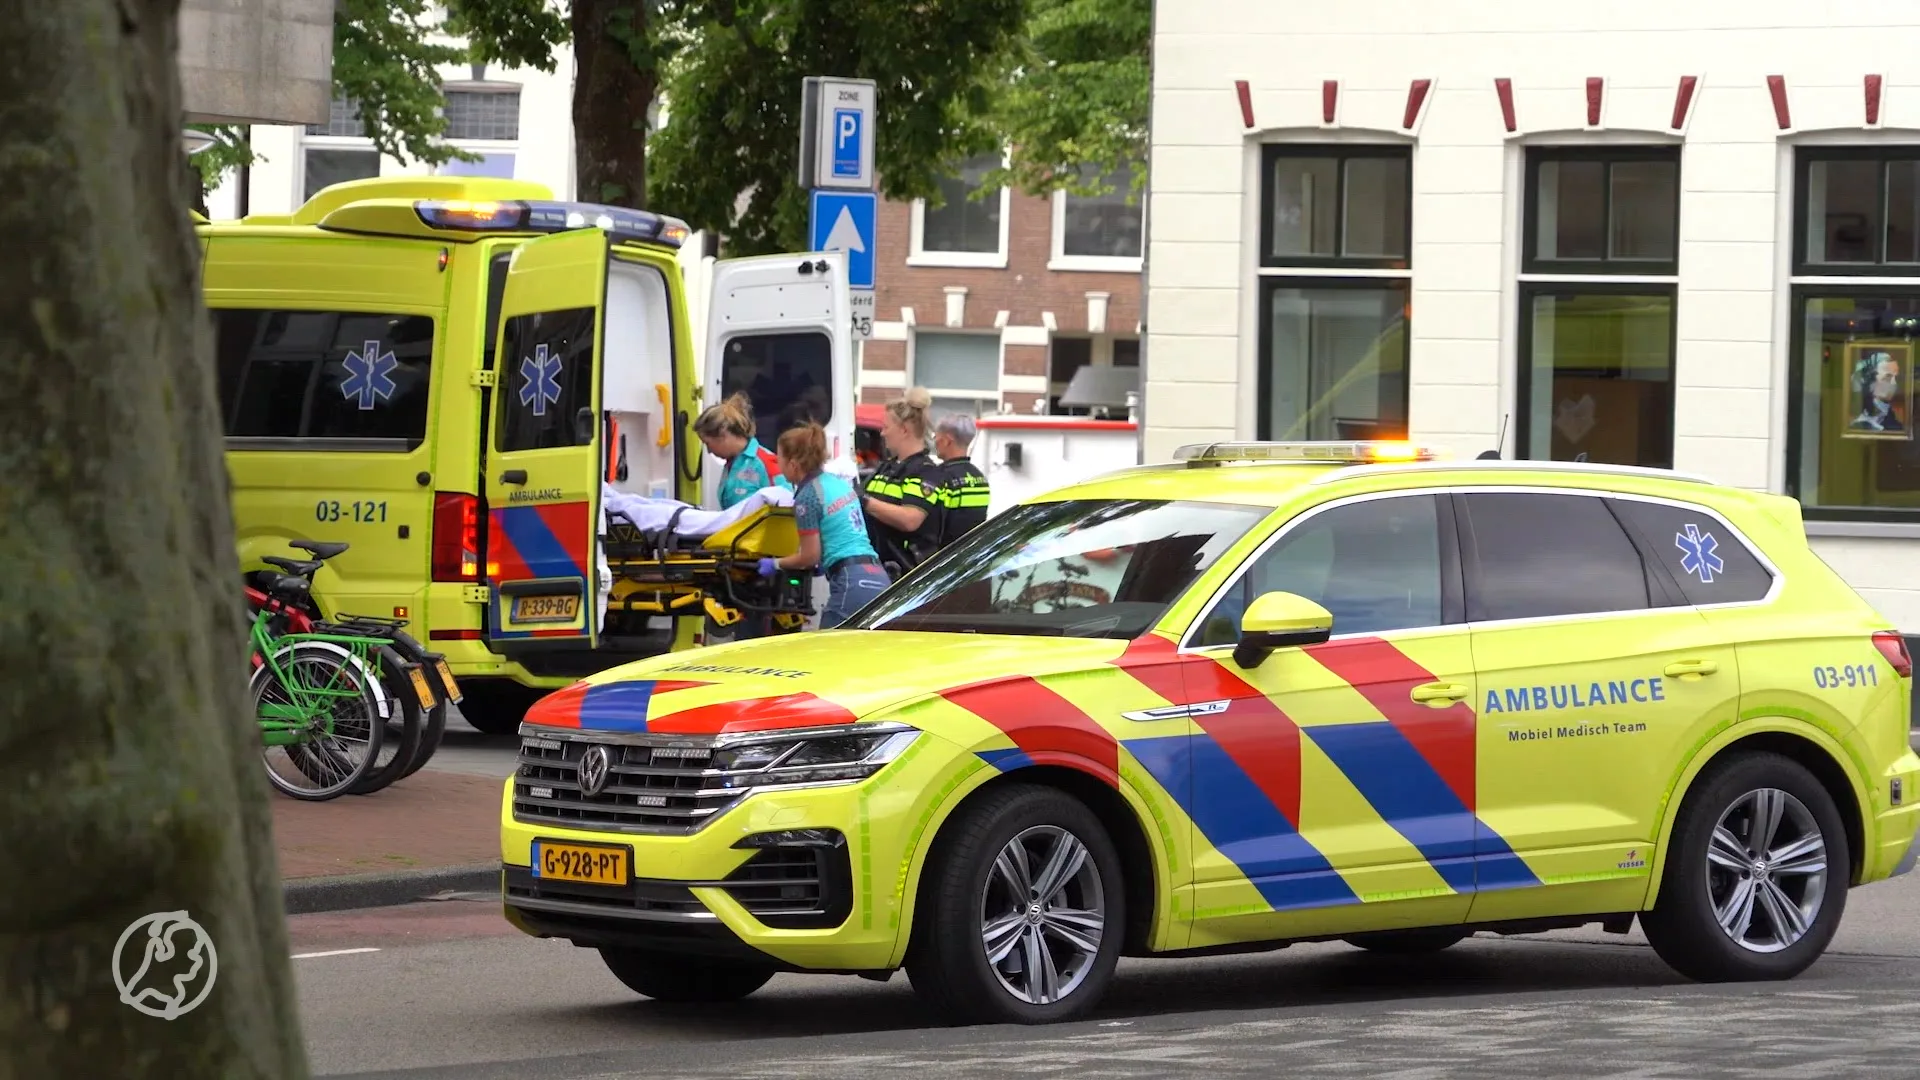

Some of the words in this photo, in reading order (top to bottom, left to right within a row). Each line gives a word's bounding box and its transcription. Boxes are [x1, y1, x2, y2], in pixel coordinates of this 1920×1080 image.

[838, 91, 860, 101] ZONE
[839, 115, 857, 149] P
[509, 488, 562, 502] AMBULANCE
[316, 501, 387, 522] 03-121
[520, 598, 573, 616] R-339-BG
[655, 665, 813, 679] AMBULANCE
[1813, 664, 1878, 688] 03-911
[1485, 677, 1665, 714] AMBULANCE
[1508, 728, 1553, 742] Mobiel
[1557, 723, 1609, 738] Medisch
[1613, 722, 1647, 733] Team
[545, 848, 620, 880] G-928-PT
[1617, 860, 1645, 868] VISSER
